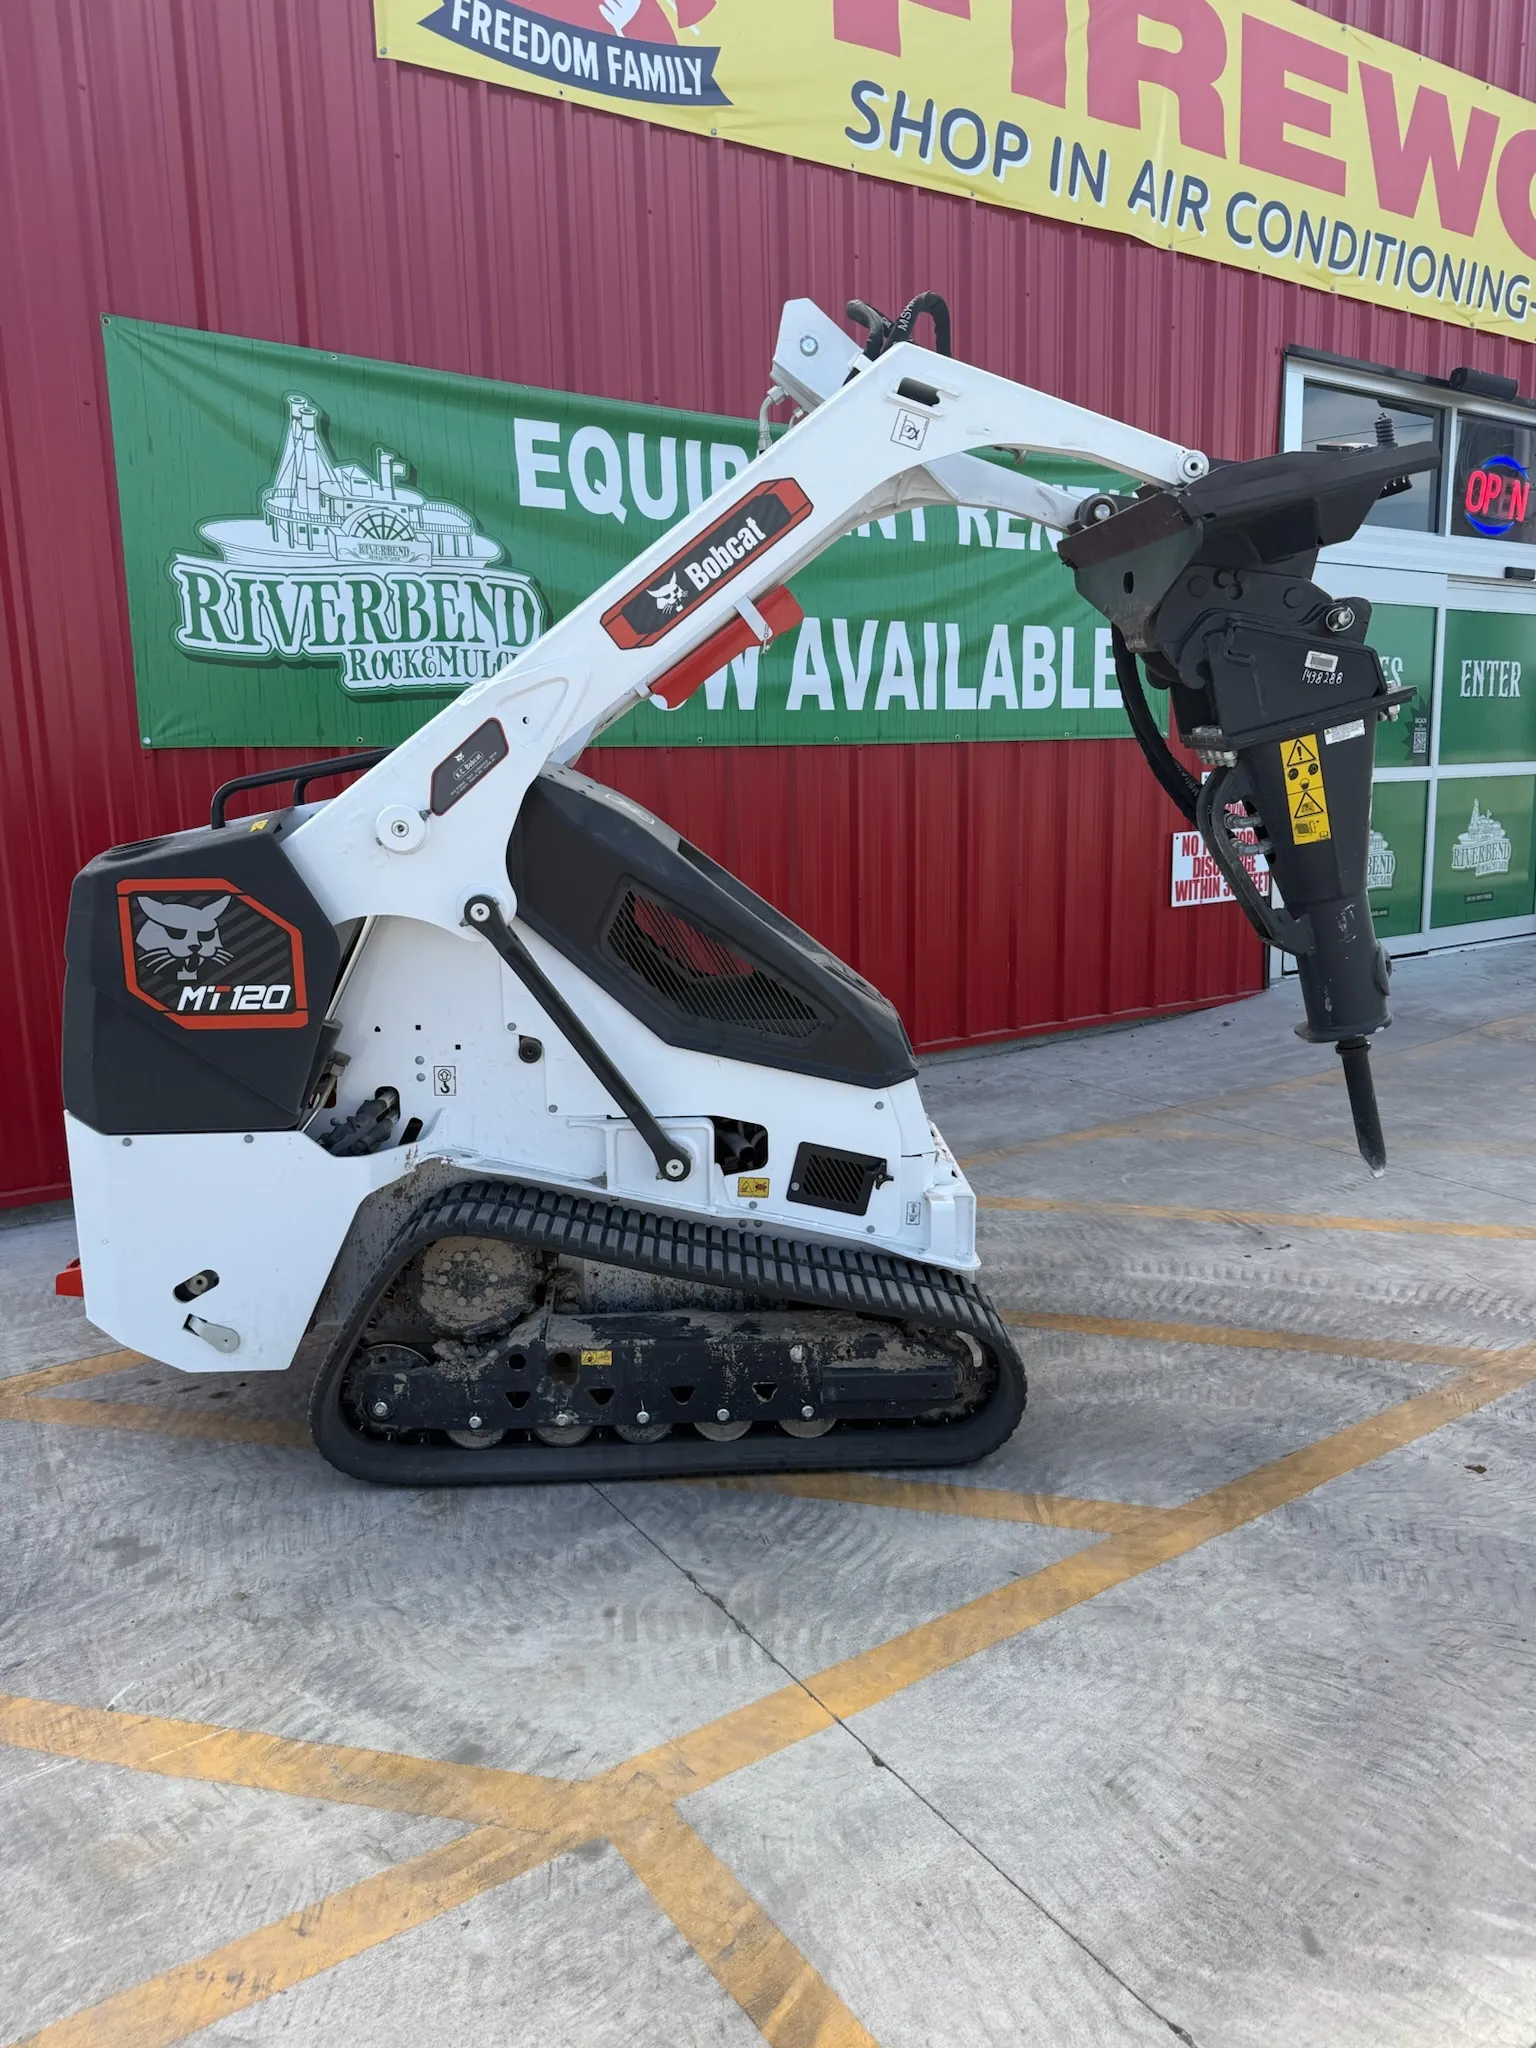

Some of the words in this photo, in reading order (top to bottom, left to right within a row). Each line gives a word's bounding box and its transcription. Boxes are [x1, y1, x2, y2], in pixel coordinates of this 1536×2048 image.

[452, 0, 599, 81] FREEDOM
[606, 45, 702, 96] FAMILY
[845, 79, 1030, 181] SHOP
[1049, 136, 1110, 207] IN
[1128, 159, 1210, 236] AIR
[1465, 469, 1531, 522] OPEN
[684, 517, 766, 591] Bobcat
[175, 569, 536, 648] RIVERBEND
[786, 617, 1123, 711] AVAILABLE
[1460, 659, 1522, 698] ENTER
[1182, 834, 1199, 857] NO
[1453, 841, 1509, 867] RIVERBEND
[1175, 877, 1221, 902] WITHIN
